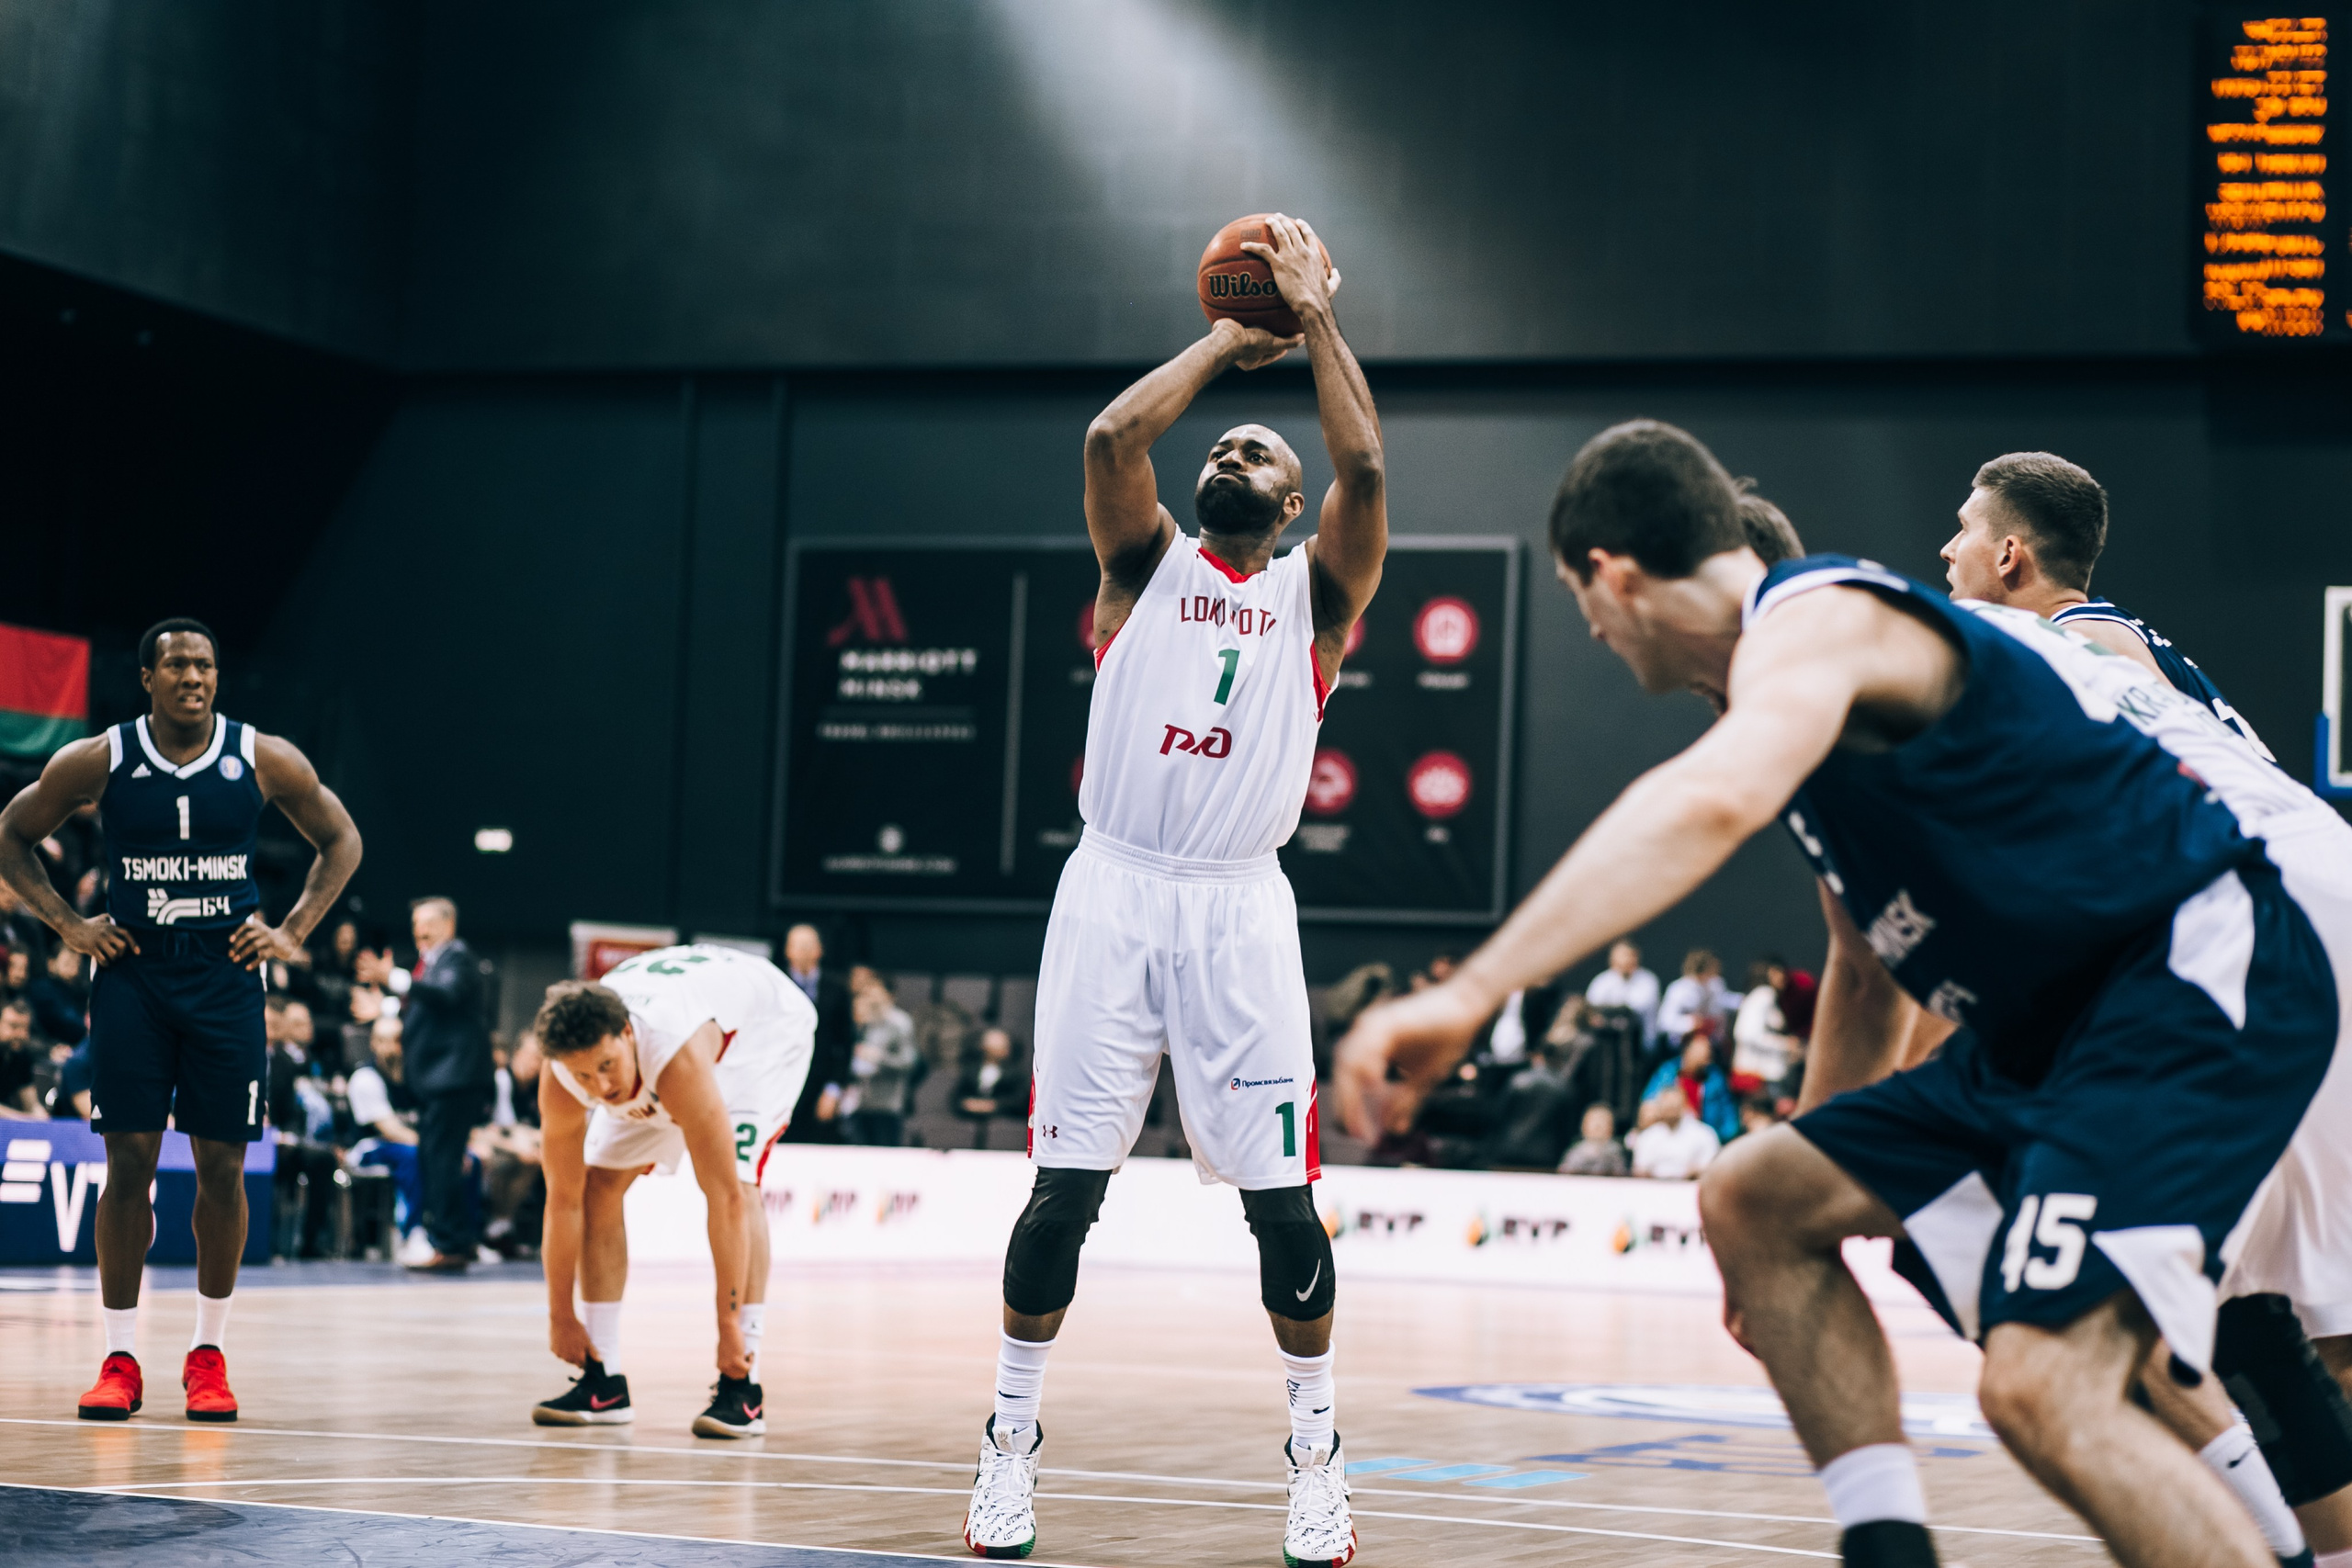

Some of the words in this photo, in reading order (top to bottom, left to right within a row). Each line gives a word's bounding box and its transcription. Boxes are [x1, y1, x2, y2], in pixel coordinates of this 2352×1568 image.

[1208, 271, 1279, 299] Wilso
[1213, 648, 1240, 705] 1
[175, 795, 190, 840] 1
[121, 854, 248, 881] TSMOKI-MINSK
[247, 1079, 259, 1126] 1
[1241, 1077, 1295, 1089] Промсвязьбанк
[736, 1122, 757, 1163] 2
[1274, 1101, 1296, 1157] 1
